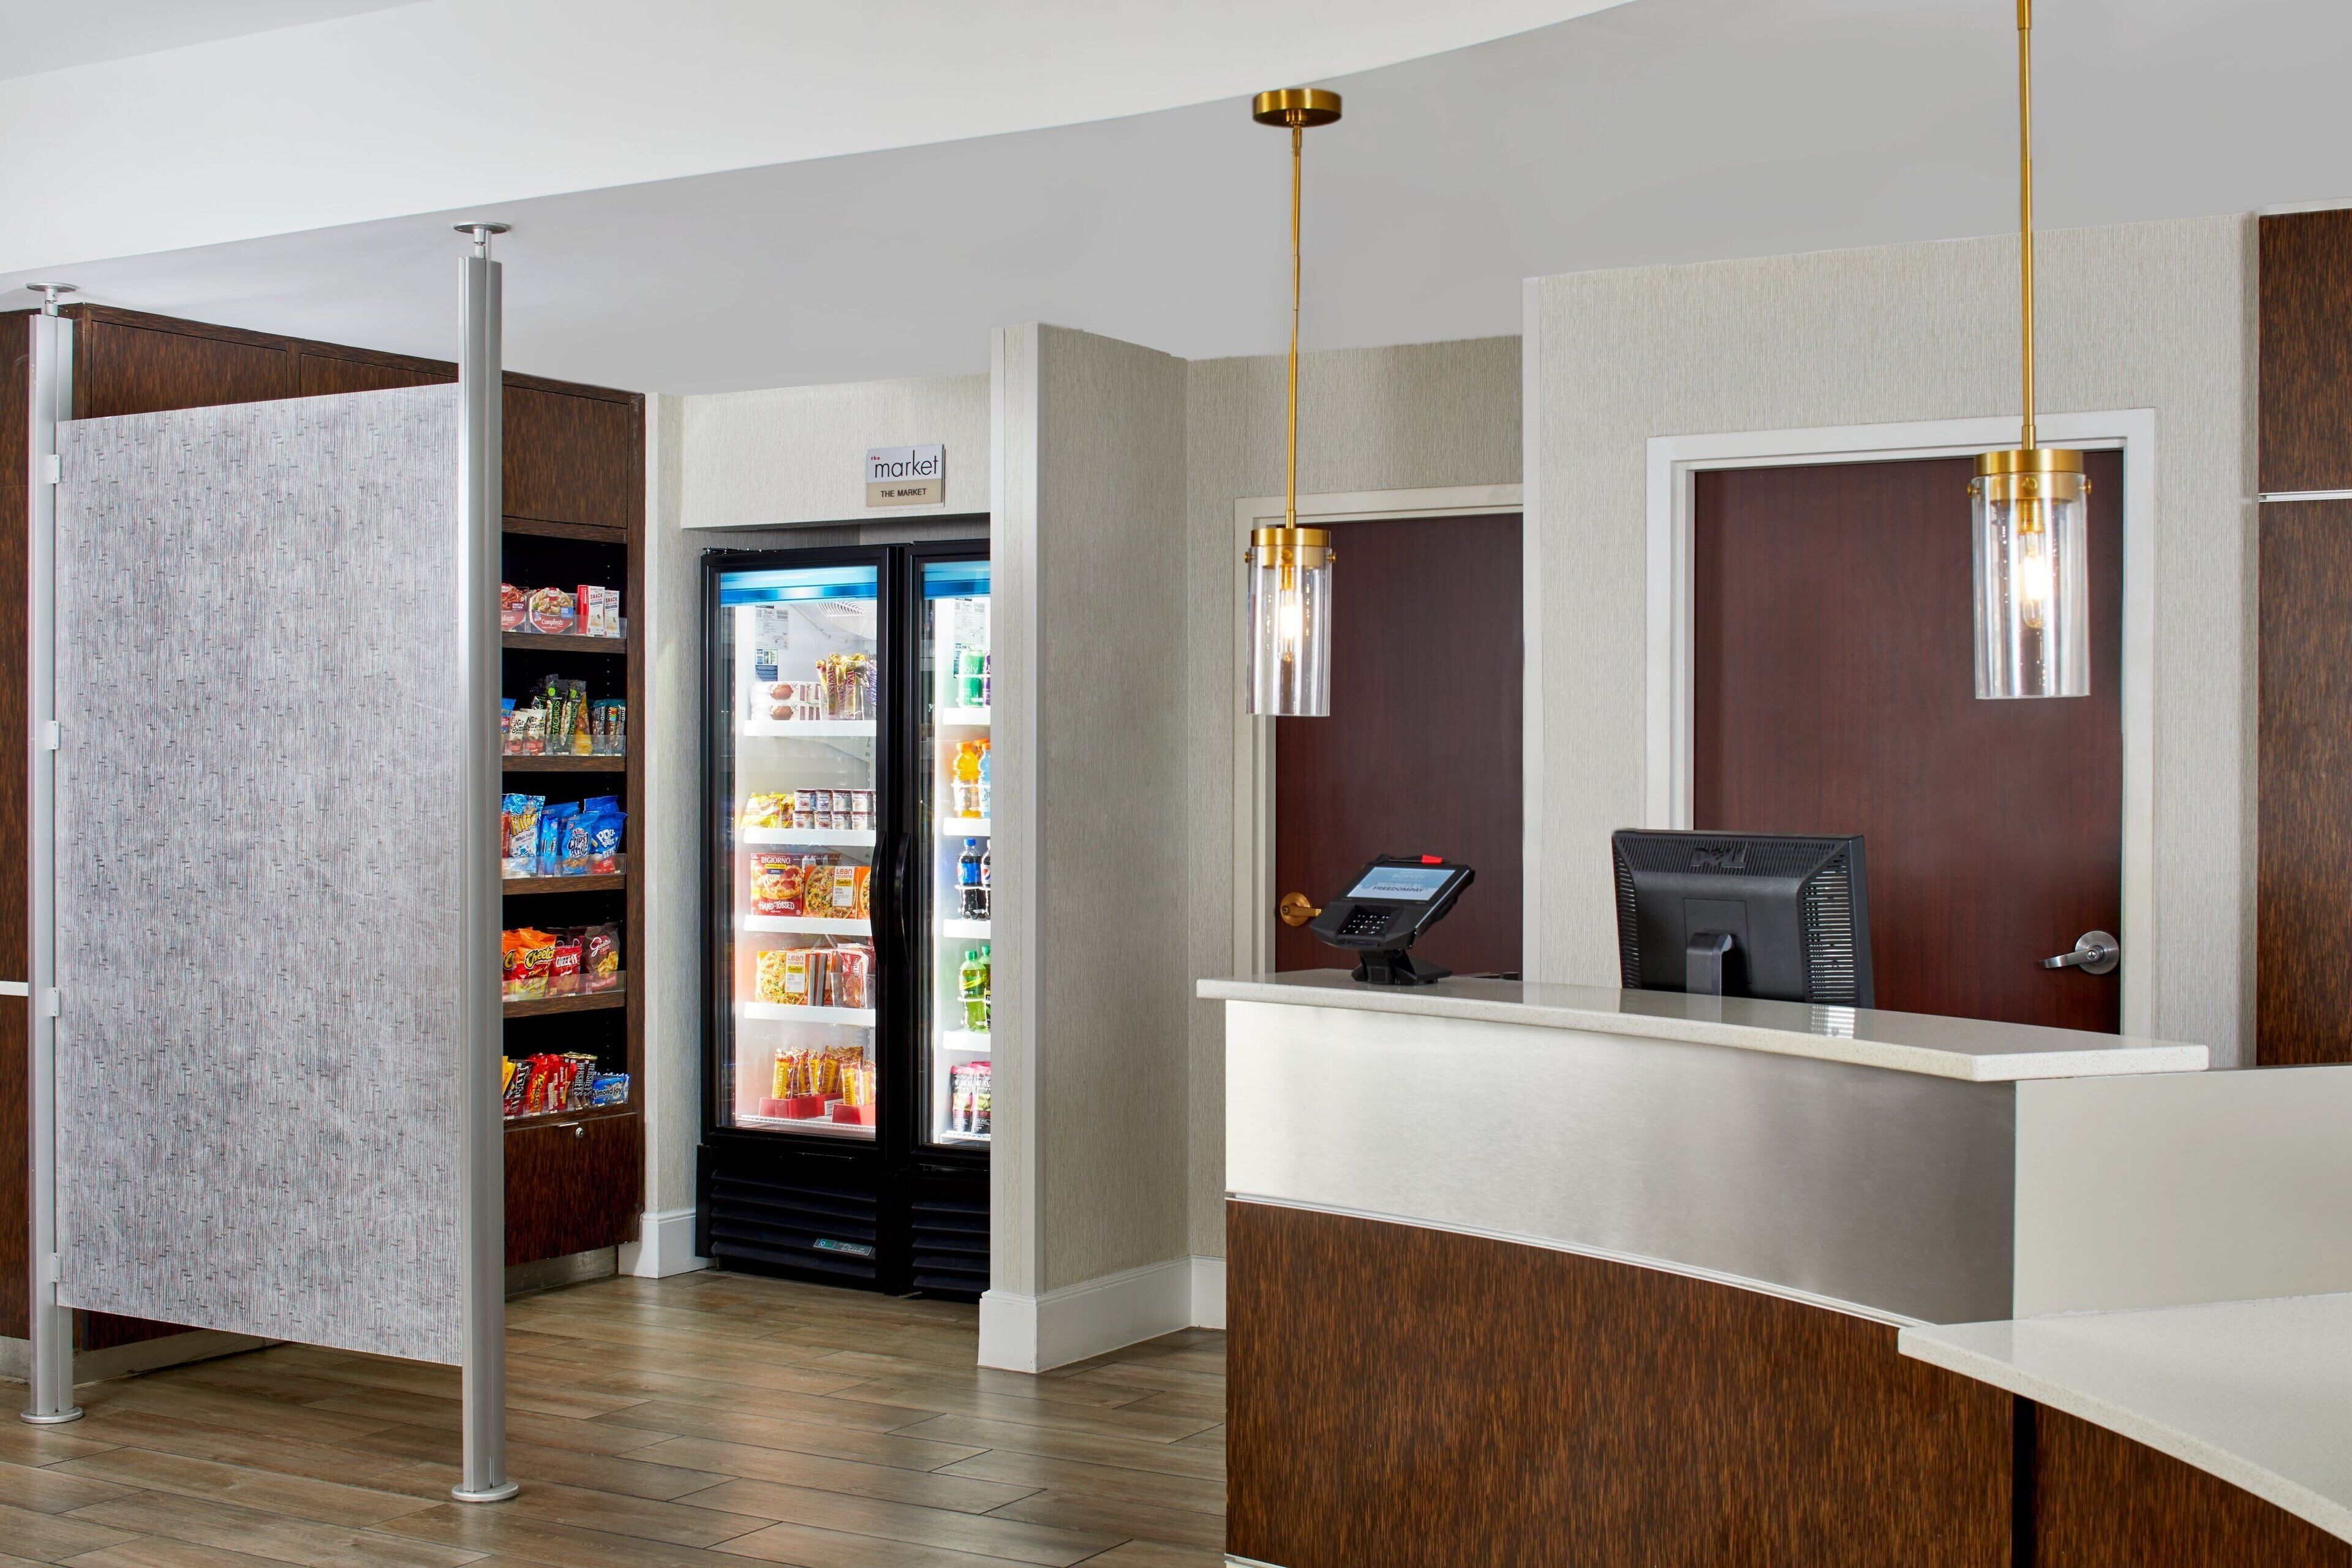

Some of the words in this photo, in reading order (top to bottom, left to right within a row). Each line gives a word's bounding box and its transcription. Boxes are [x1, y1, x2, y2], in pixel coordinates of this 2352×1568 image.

[875, 450, 938, 478] market
[897, 488, 927, 497] MARKET
[541, 618, 564, 627] Compleats
[510, 812, 537, 837] Flipz
[758, 900, 795, 911] HAND-TOSSED
[594, 1088, 612, 1098] Almond
[612, 1087, 622, 1095] Joy
